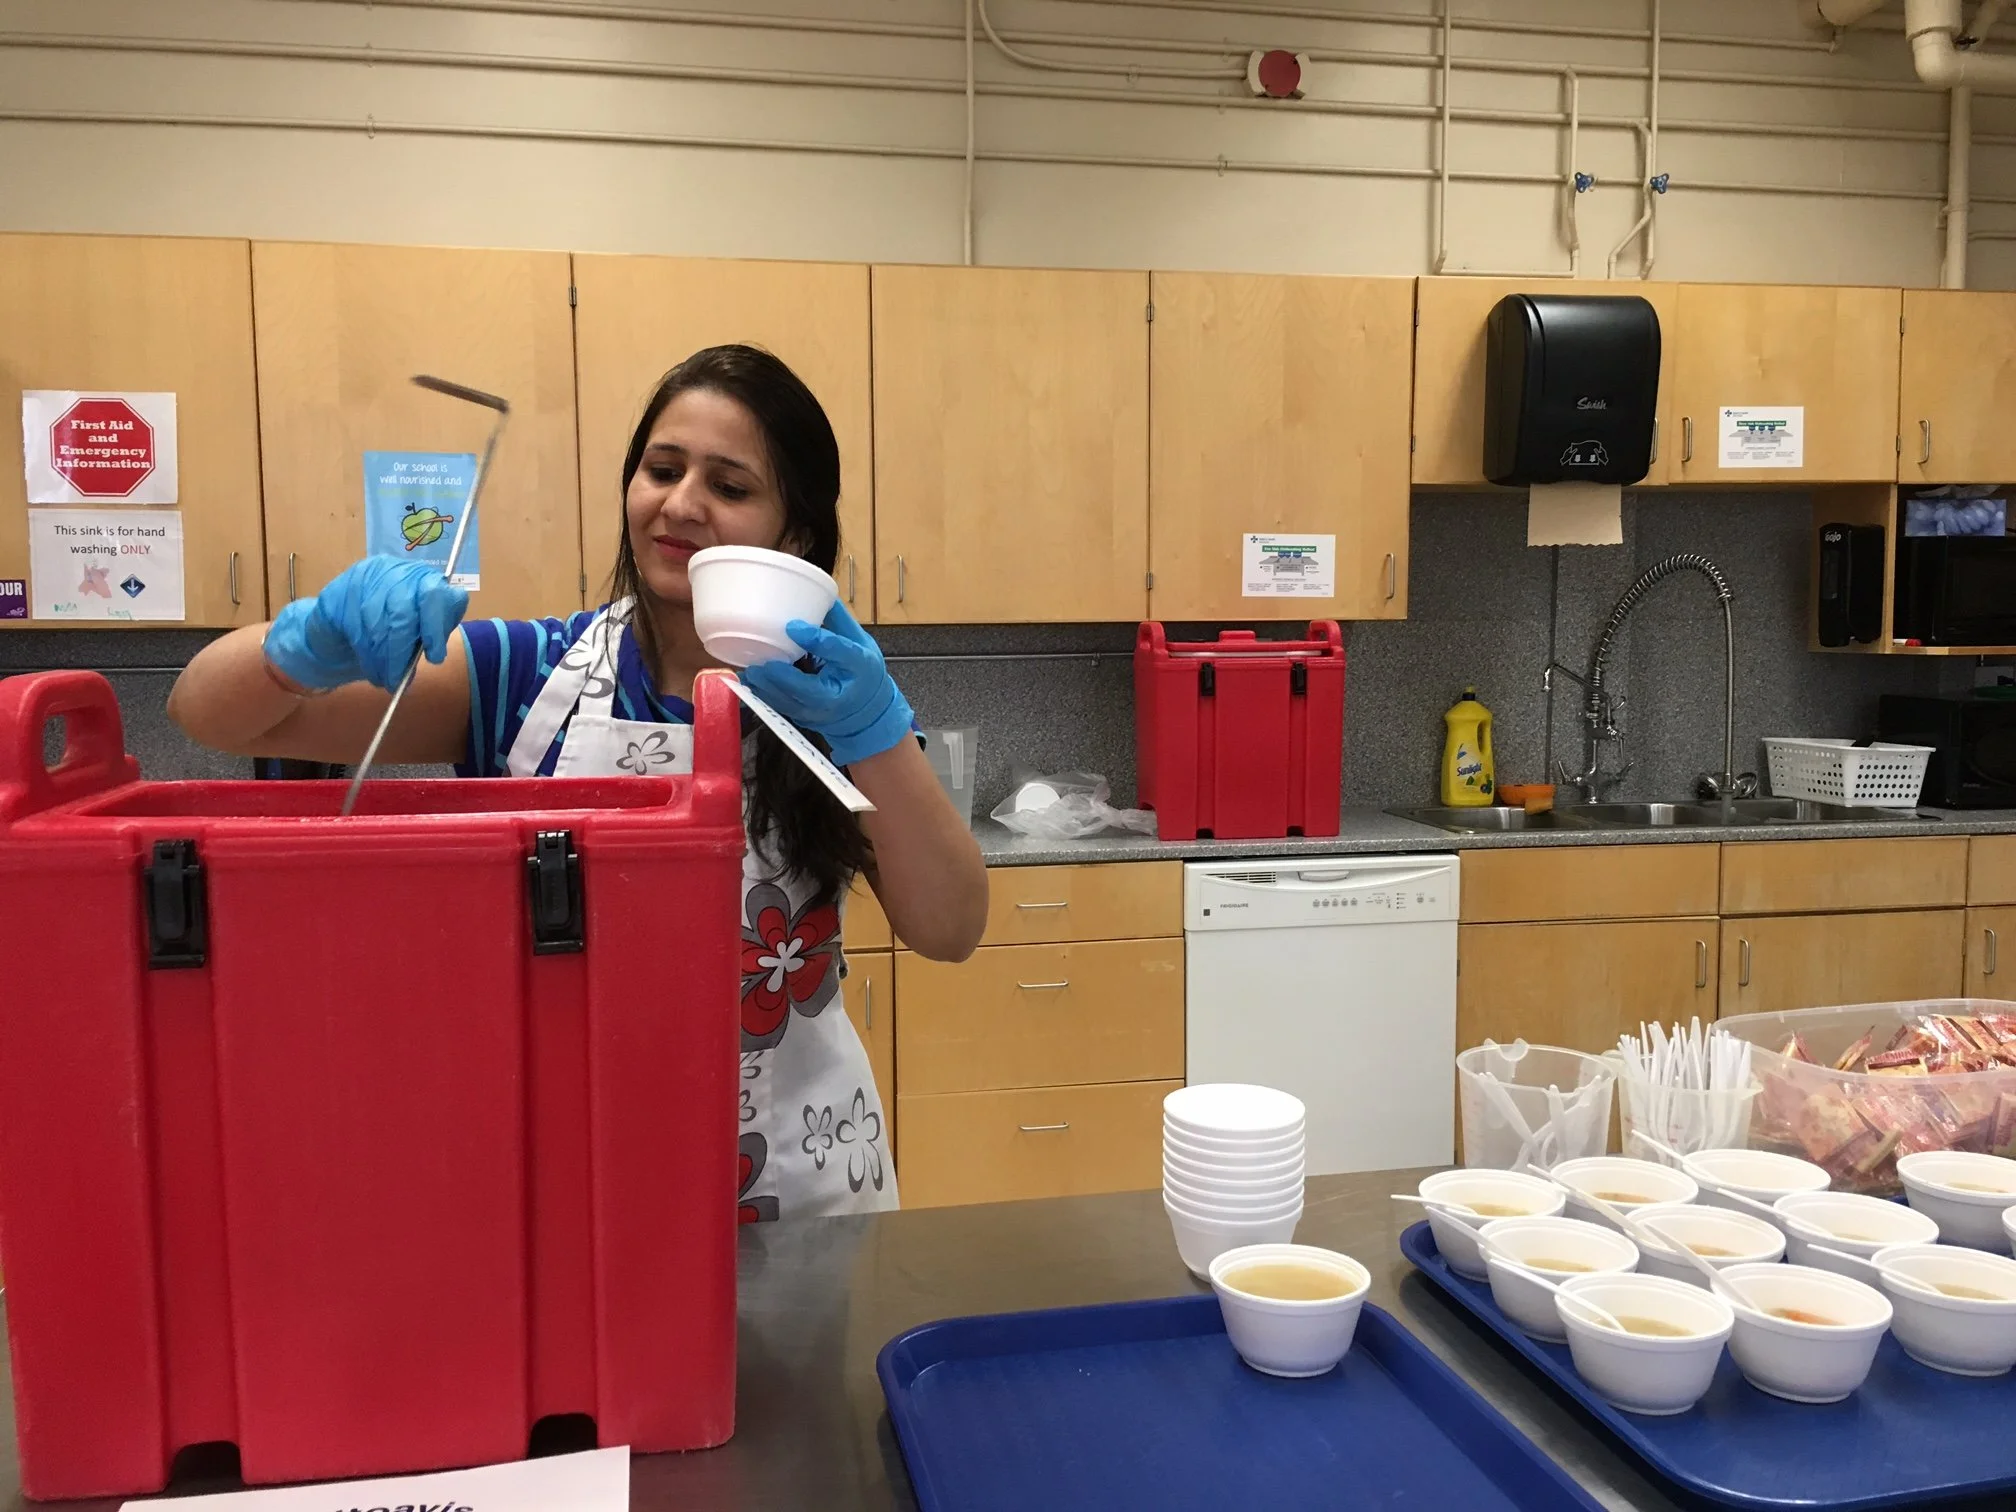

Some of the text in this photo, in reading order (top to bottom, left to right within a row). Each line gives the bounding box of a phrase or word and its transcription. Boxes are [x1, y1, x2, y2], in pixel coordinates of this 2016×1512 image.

[71, 420, 134, 430] First Aid
[88, 433, 118, 443] and
[60, 446, 147, 458] Emergency
[55, 458, 151, 469] Information
[393, 462, 448, 473] Our school is
[380, 475, 462, 485] well nourished and
[54, 525, 165, 537] This sink is for hand
[70, 544, 151, 556] washing ONLY
